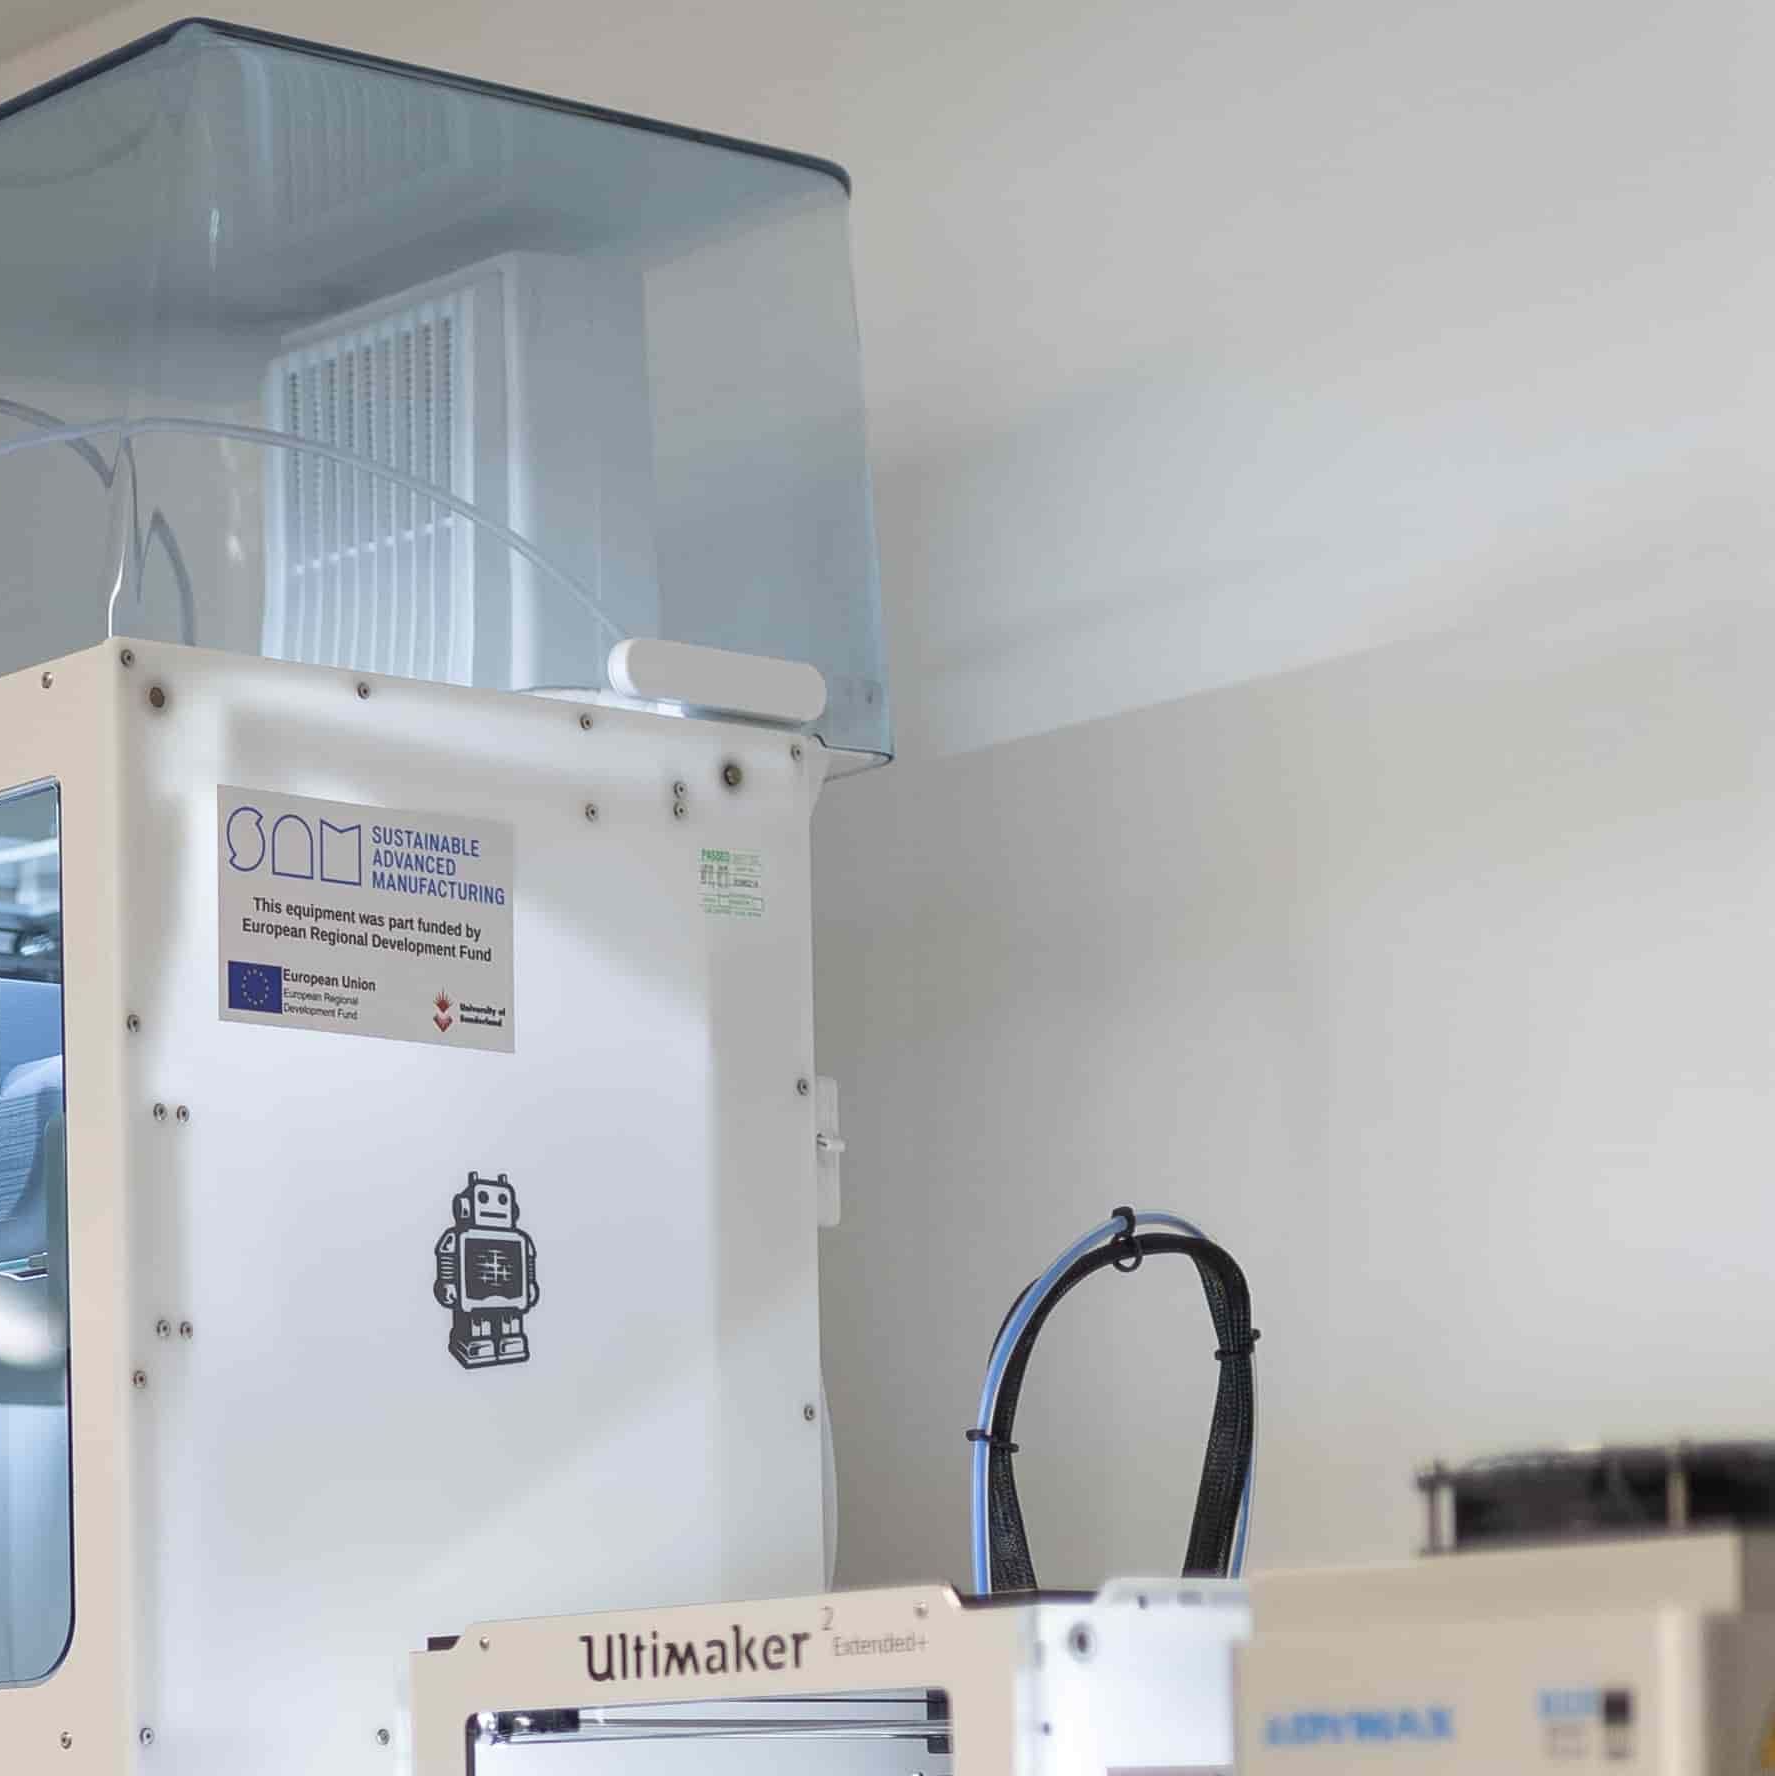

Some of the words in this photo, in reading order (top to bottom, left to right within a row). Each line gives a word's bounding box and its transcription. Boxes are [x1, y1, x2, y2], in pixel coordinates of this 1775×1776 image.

[372, 826, 480, 857] SUSTAINABLE
[372, 849, 456, 876] ADVANCED
[372, 871, 505, 905] MANUFACTURING
[253, 897, 282, 914] This
[286, 903, 355, 924] equipment
[359, 913, 384, 927] was
[389, 917, 414, 931] part
[418, 918, 461, 937] funded
[466, 923, 481, 942] by
[242, 918, 306, 939] European
[311, 926, 368, 946] Regional
[372, 934, 455, 958] Development
[460, 946, 491, 962] Fund
[284, 969, 338, 988] European
[342, 976, 376, 992] Union
[284, 988, 322, 1002] European
[324, 992, 359, 1006] Regional
[284, 1003, 335, 1018] Development
[338, 1009, 358, 1020] Fund
[460, 1003, 496, 1017] University
[821, 1606, 834, 1631] 2
[833, 1632, 930, 1656] Extended+
